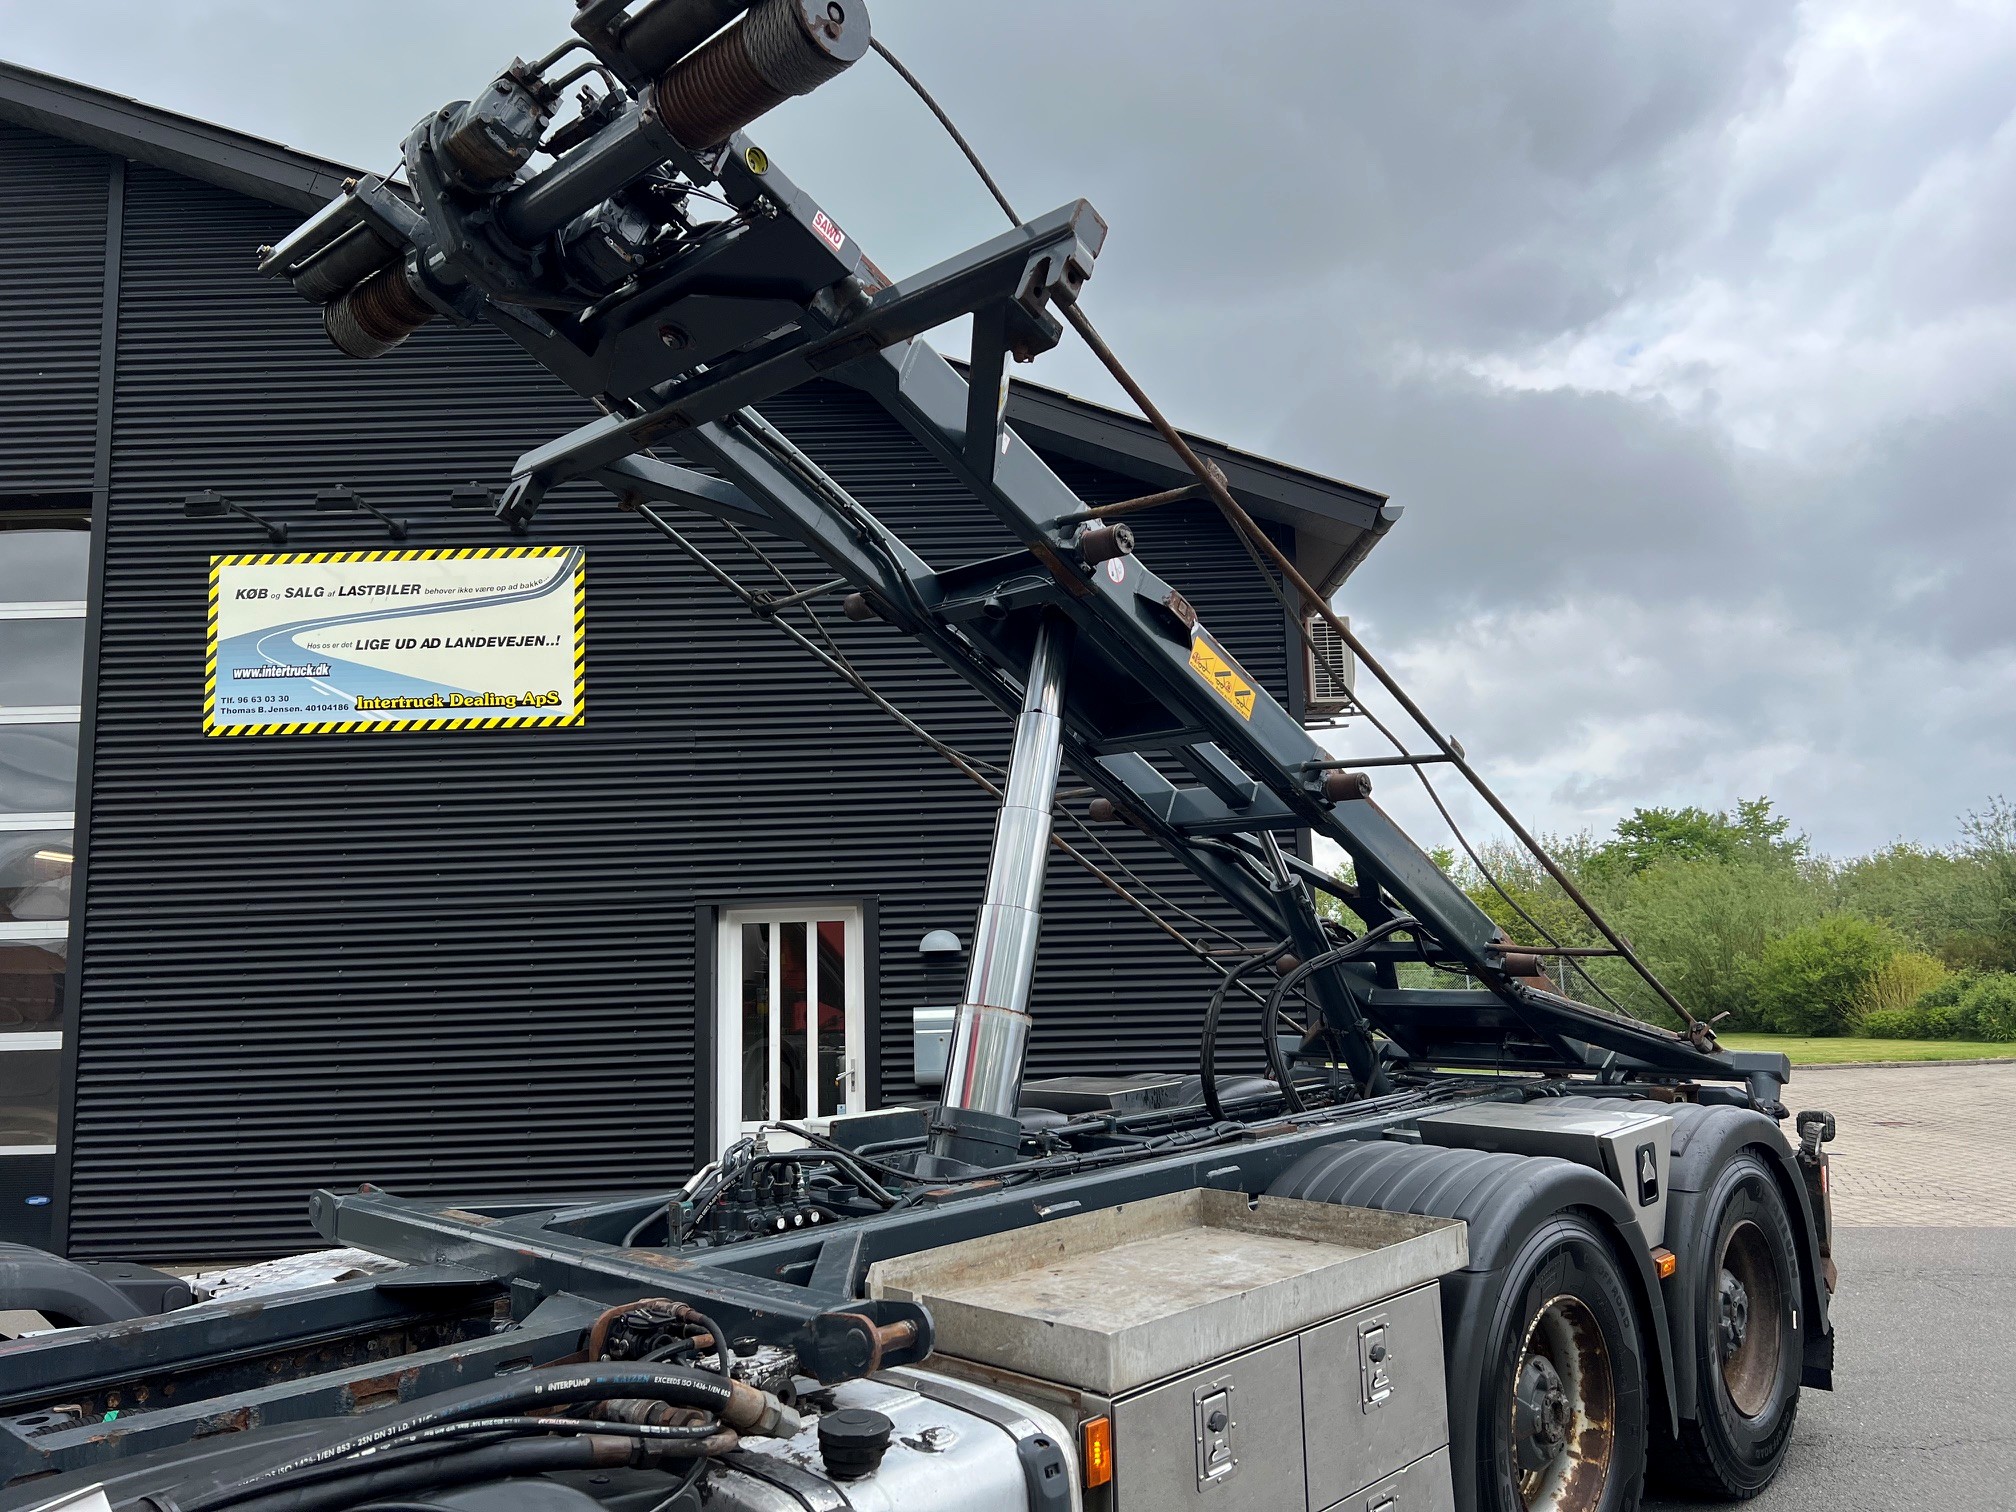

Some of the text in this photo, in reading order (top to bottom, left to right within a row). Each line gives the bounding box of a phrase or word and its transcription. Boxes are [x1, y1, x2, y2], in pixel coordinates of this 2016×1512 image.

[815, 213, 842, 245] SAWO
[235, 588, 268, 600] KØB
[284, 586, 325, 598] SALG
[338, 584, 421, 597] LASTBILER
[355, 638, 391, 650] LIGE
[394, 638, 417, 649] UD
[419, 637, 442, 649] AD
[445, 635, 561, 648] LANDEVEJEN..!
[233, 663, 330, 679] www.intertruck.dk
[356, 690, 561, 710] Intertruck Dealing ApS
[220, 707, 256, 715] Thomas
[305, 704, 349, 712] 40104186
[547, 1377, 591, 1391] INTERPUMP
[654, 1376, 680, 1386] EXCEEDS
[681, 1379, 692, 1387] ISO
[720, 1388, 731, 1398] 853
[336, 1442, 351, 1454] 853
[358, 1435, 372, 1446] 2SN
[374, 1430, 386, 1440] DN
[387, 1426, 396, 1436] 31
